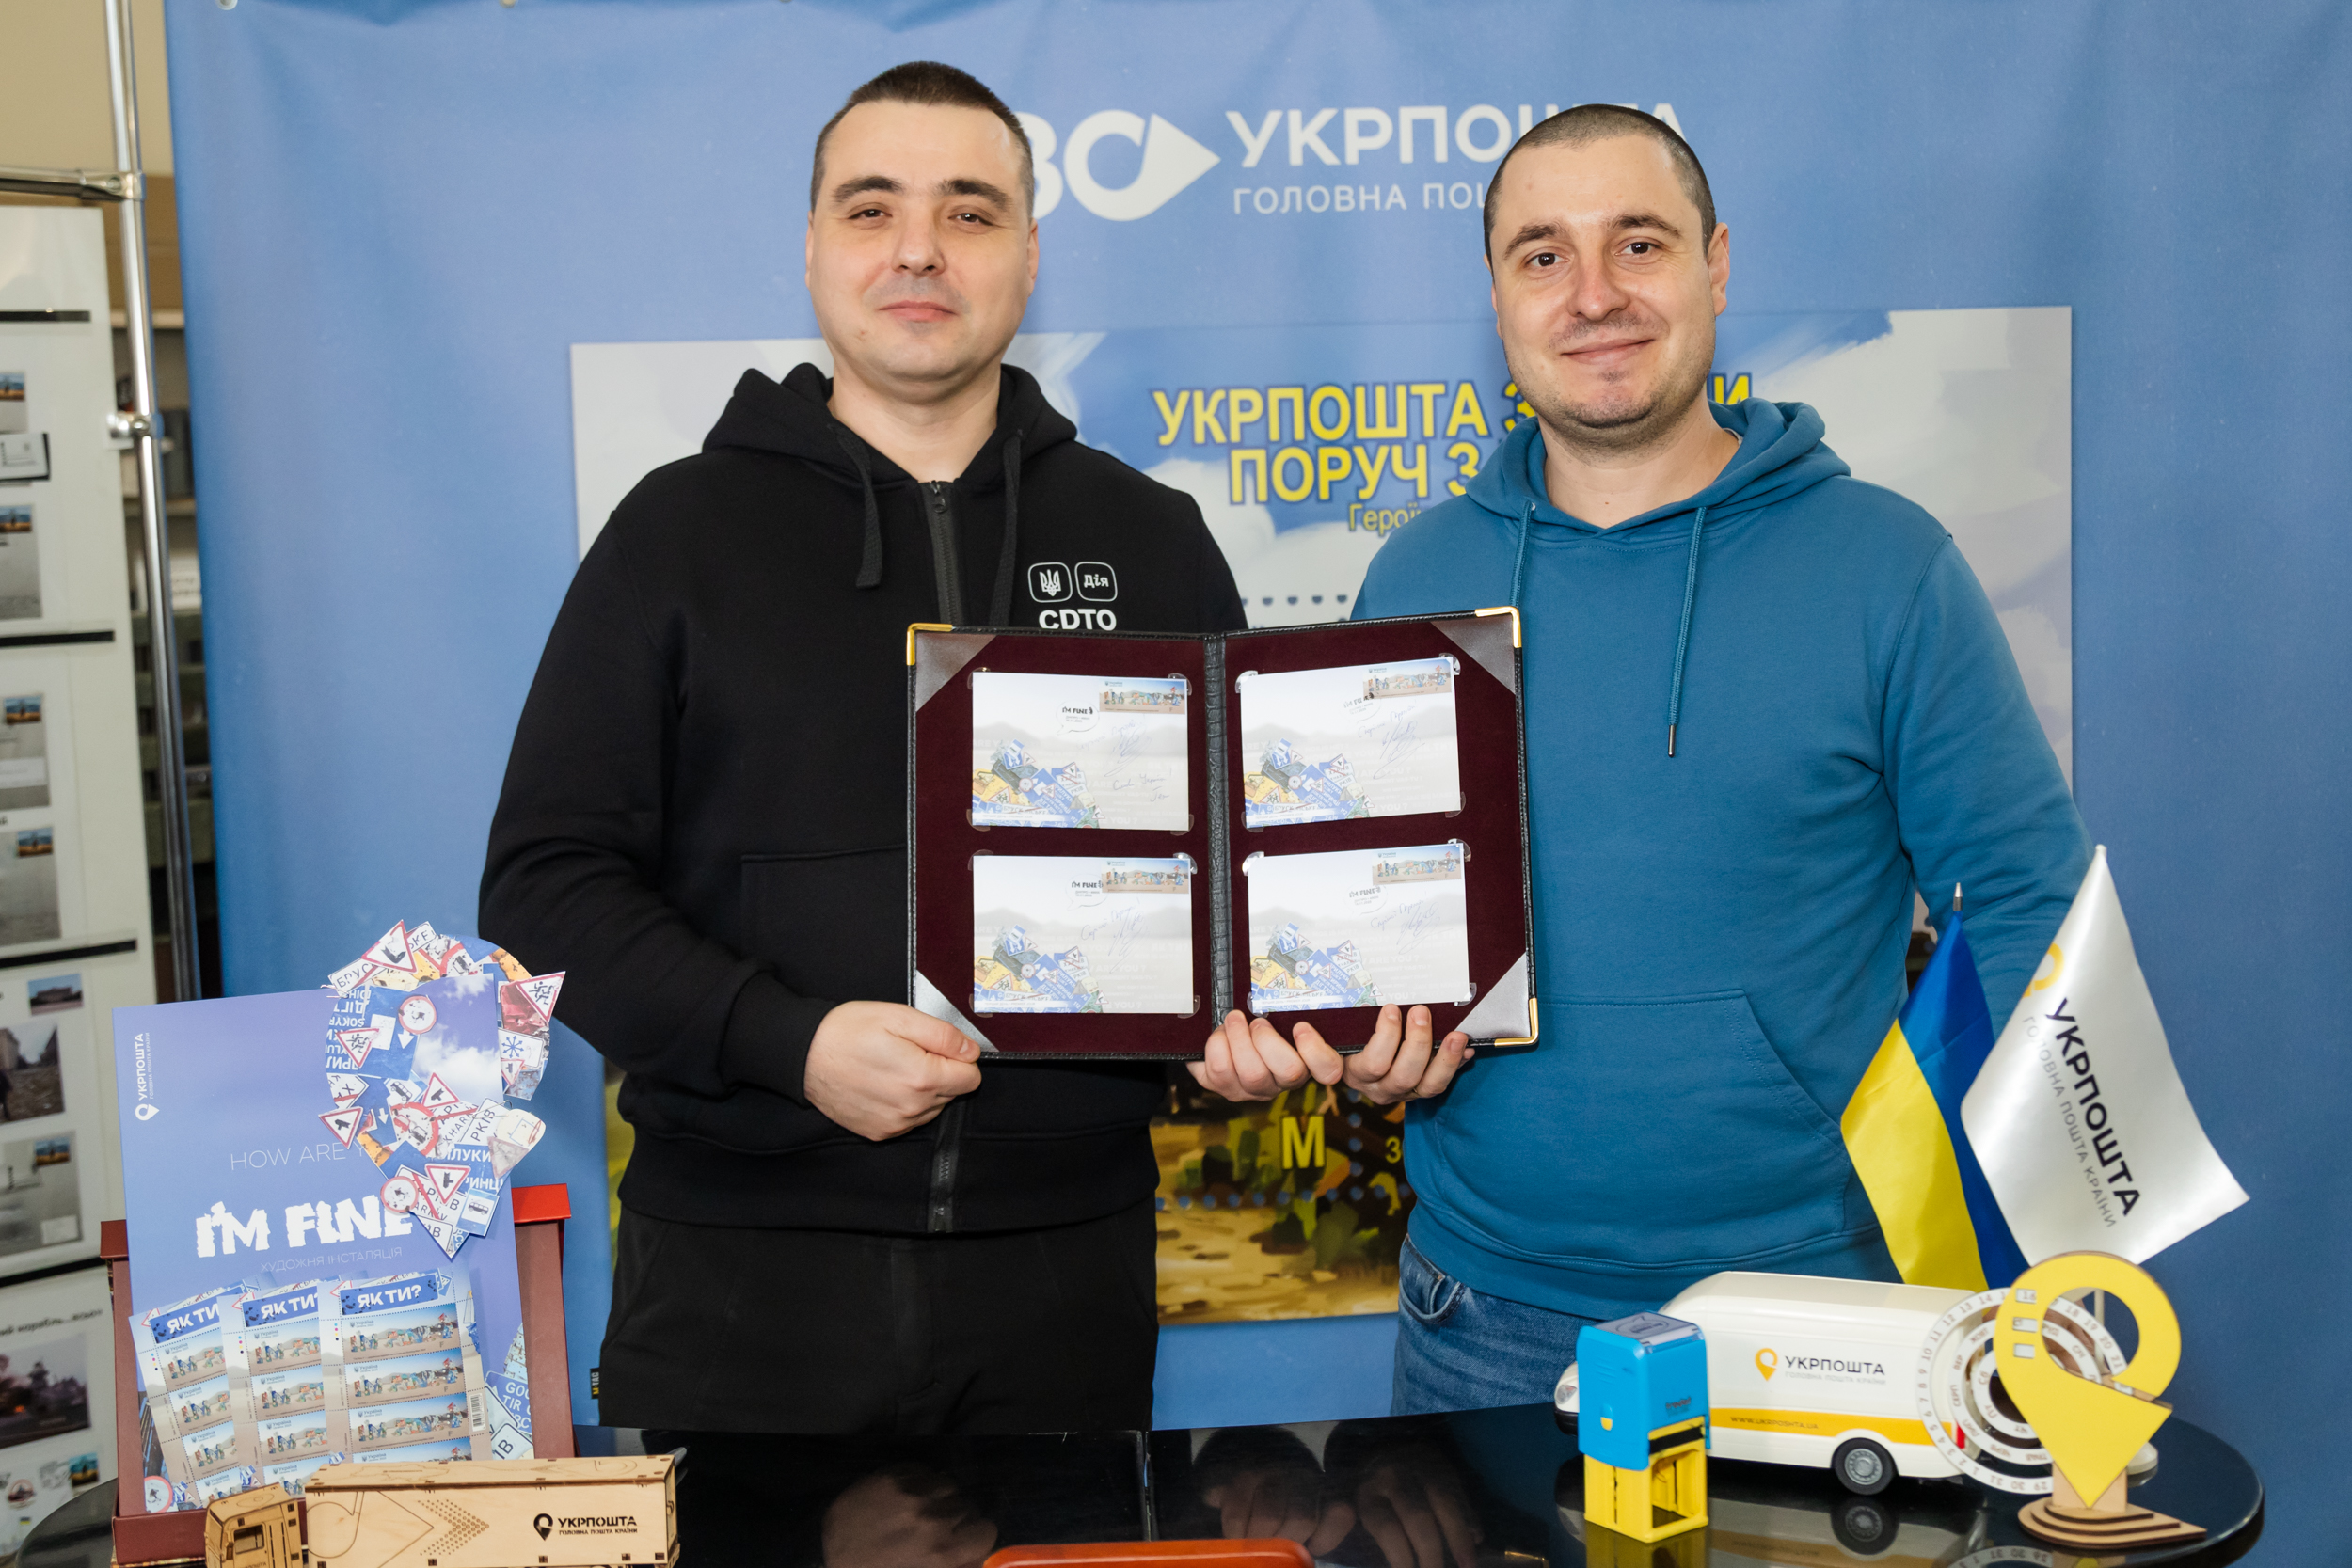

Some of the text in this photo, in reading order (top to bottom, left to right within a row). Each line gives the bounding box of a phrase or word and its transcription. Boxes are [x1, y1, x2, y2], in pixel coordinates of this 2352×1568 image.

[1233, 185, 1407, 215] ГОЛОВНА
[1153, 382, 1488, 446] УКРПОШТА
[1231, 443, 1428, 502] ПОРУЧ
[1084, 574, 1109, 589] Дія
[1039, 609, 1117, 631] CDTO
[135, 1033, 148, 1101] УКРПОШТА
[2045, 997, 2140, 1216] УКРПОШТА
[2023, 1016, 2116, 1227] ГОЛОВНА ПОШТА КРАЇНИ
[230, 1148, 291, 1170] HOW
[299, 1142, 346, 1164] ARE
[196, 1201, 271, 1258] I'M
[285, 1195, 413, 1248] FINE
[261, 1246, 403, 1273] ХУДОЖНЯ ІНСТАЛЯЦІЯ
[261, 1302, 287, 1319] ЯК
[357, 1284, 421, 1308] ЯК ТИ?
[167, 1303, 221, 1334] ЯК ТИ
[1785, 1355, 1885, 1376] УКРПОШТА
[558, 1515, 637, 1528] УКРПОШТА
